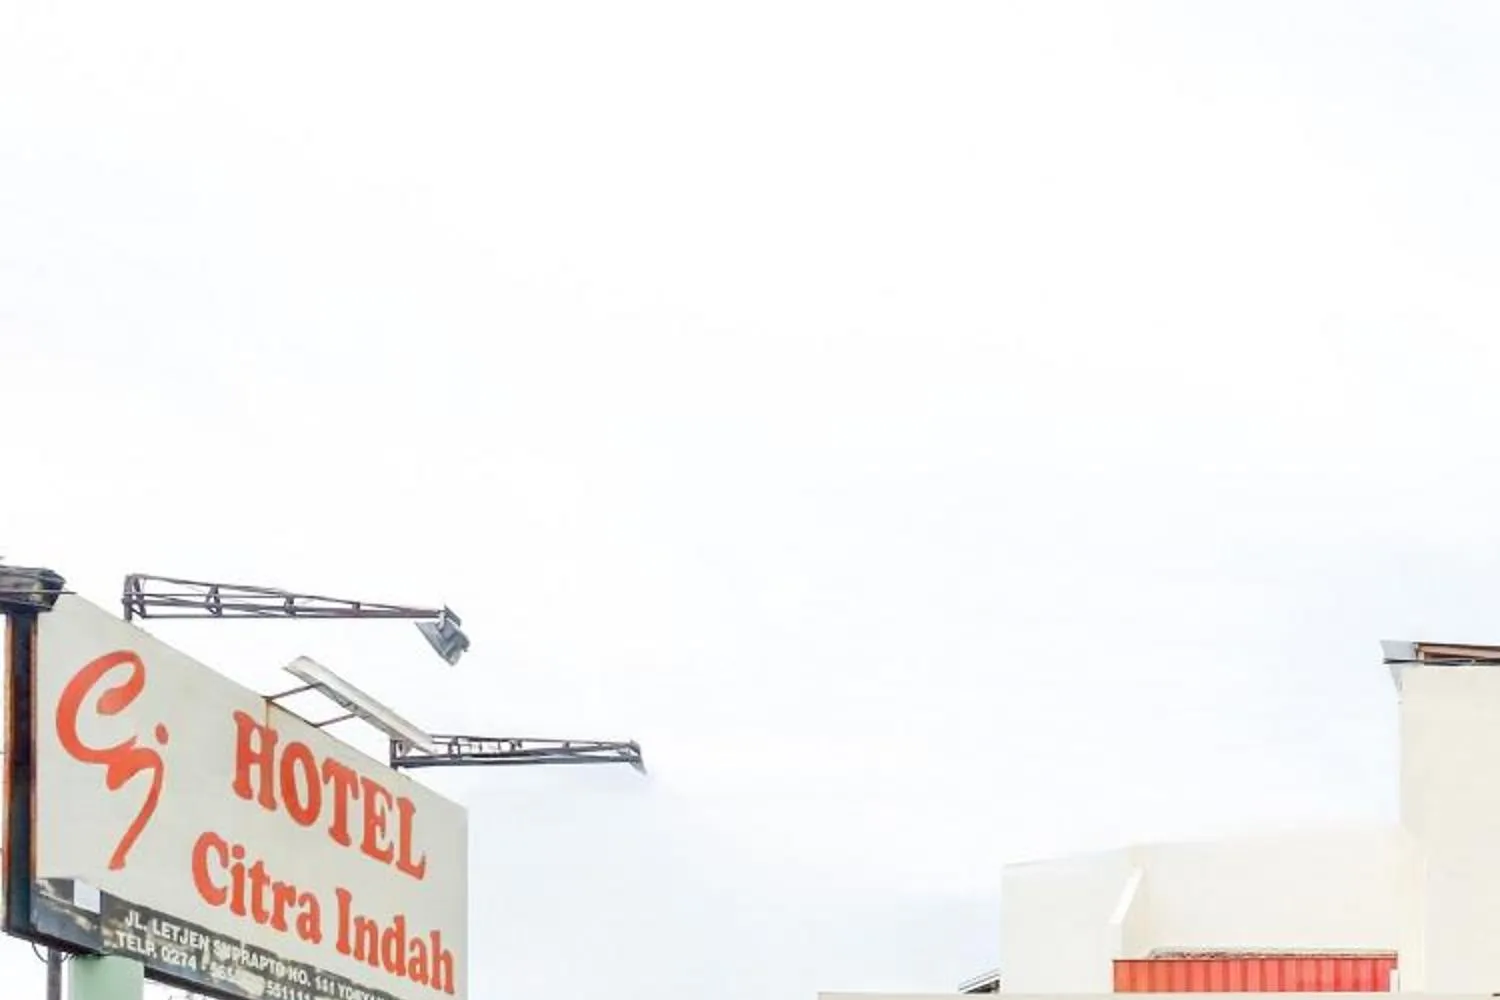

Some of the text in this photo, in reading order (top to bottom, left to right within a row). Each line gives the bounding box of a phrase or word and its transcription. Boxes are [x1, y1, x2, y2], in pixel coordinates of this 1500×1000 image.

[232, 709, 427, 881] HOTEL
[191, 831, 455, 995] Citra Indah
